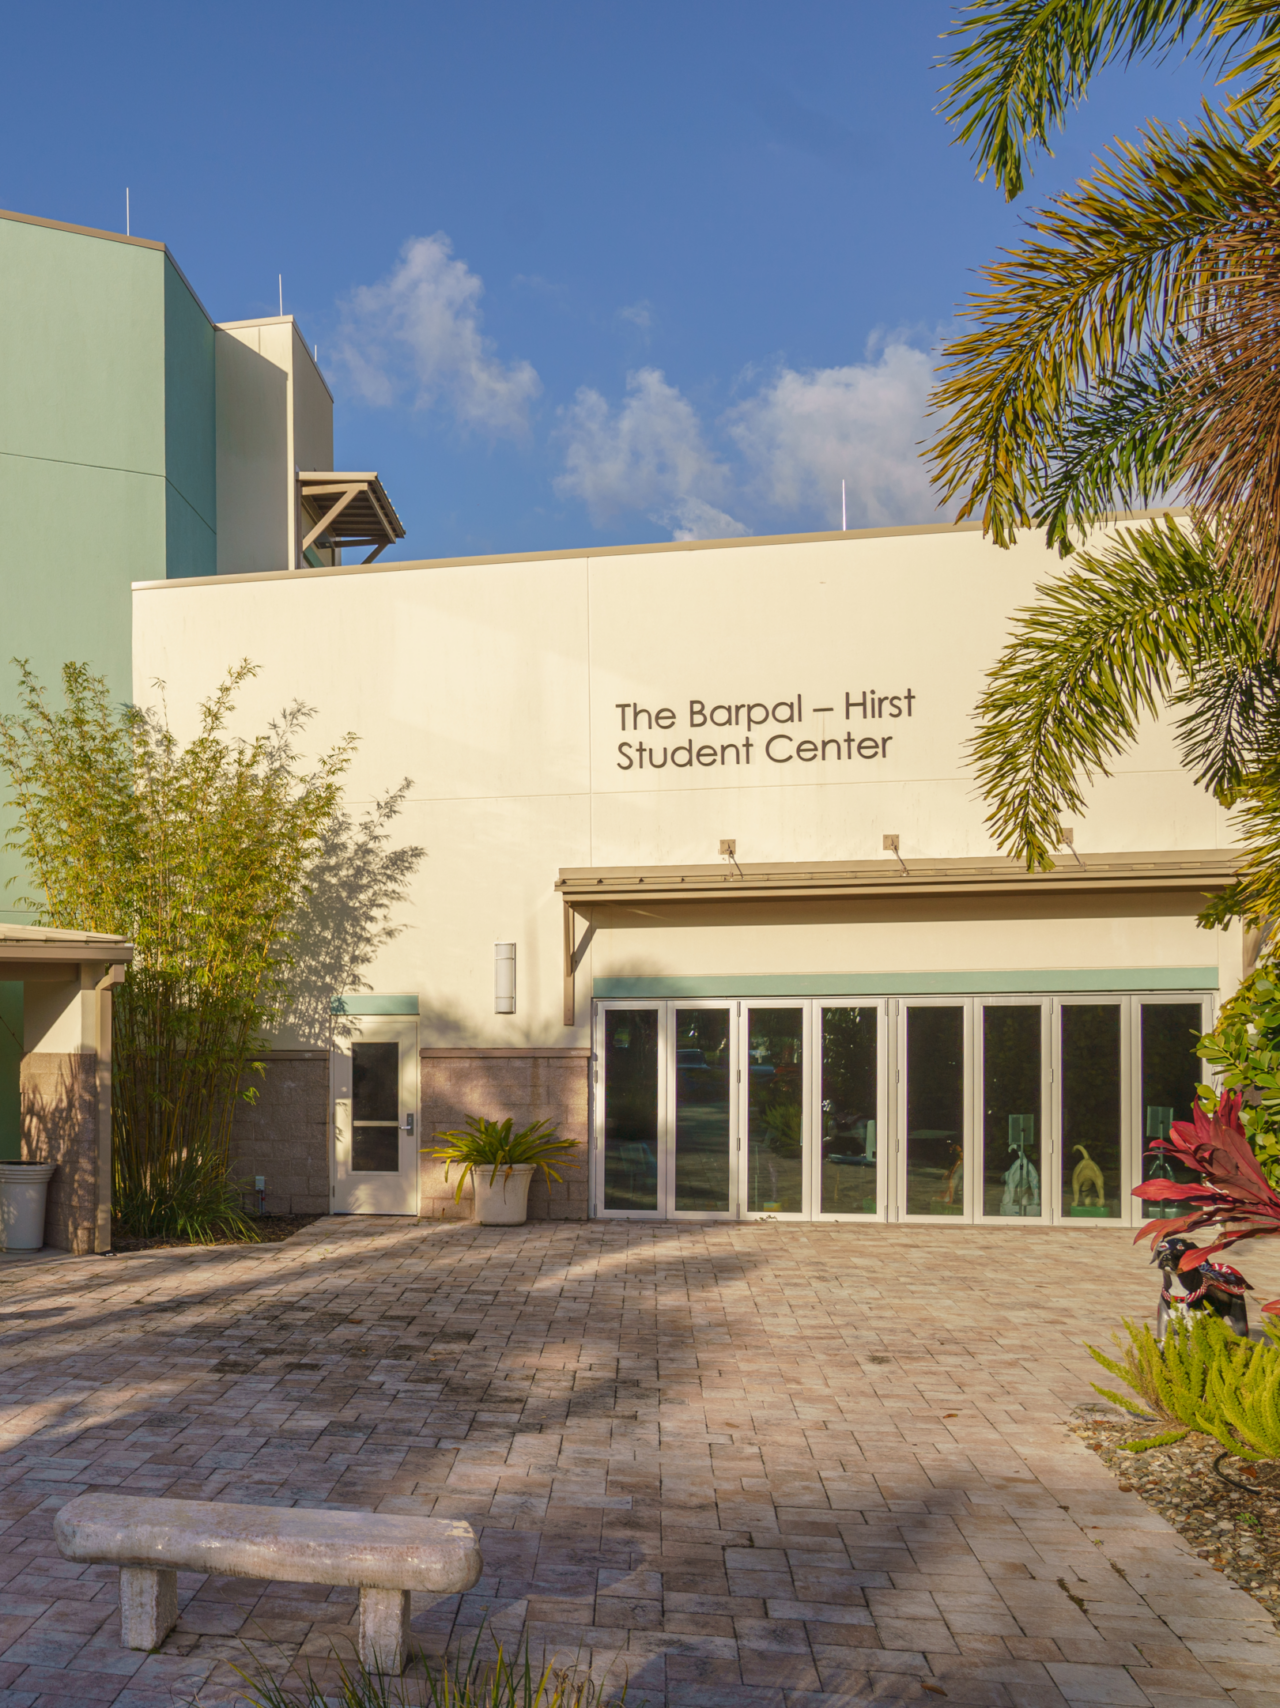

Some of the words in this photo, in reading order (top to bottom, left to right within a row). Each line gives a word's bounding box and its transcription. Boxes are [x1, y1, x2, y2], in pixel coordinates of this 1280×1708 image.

[615, 702, 677, 731] The
[689, 693, 802, 732] Barpal
[845, 688, 916, 720] Hirst
[616, 736, 754, 771] Student
[765, 731, 893, 764] Center
